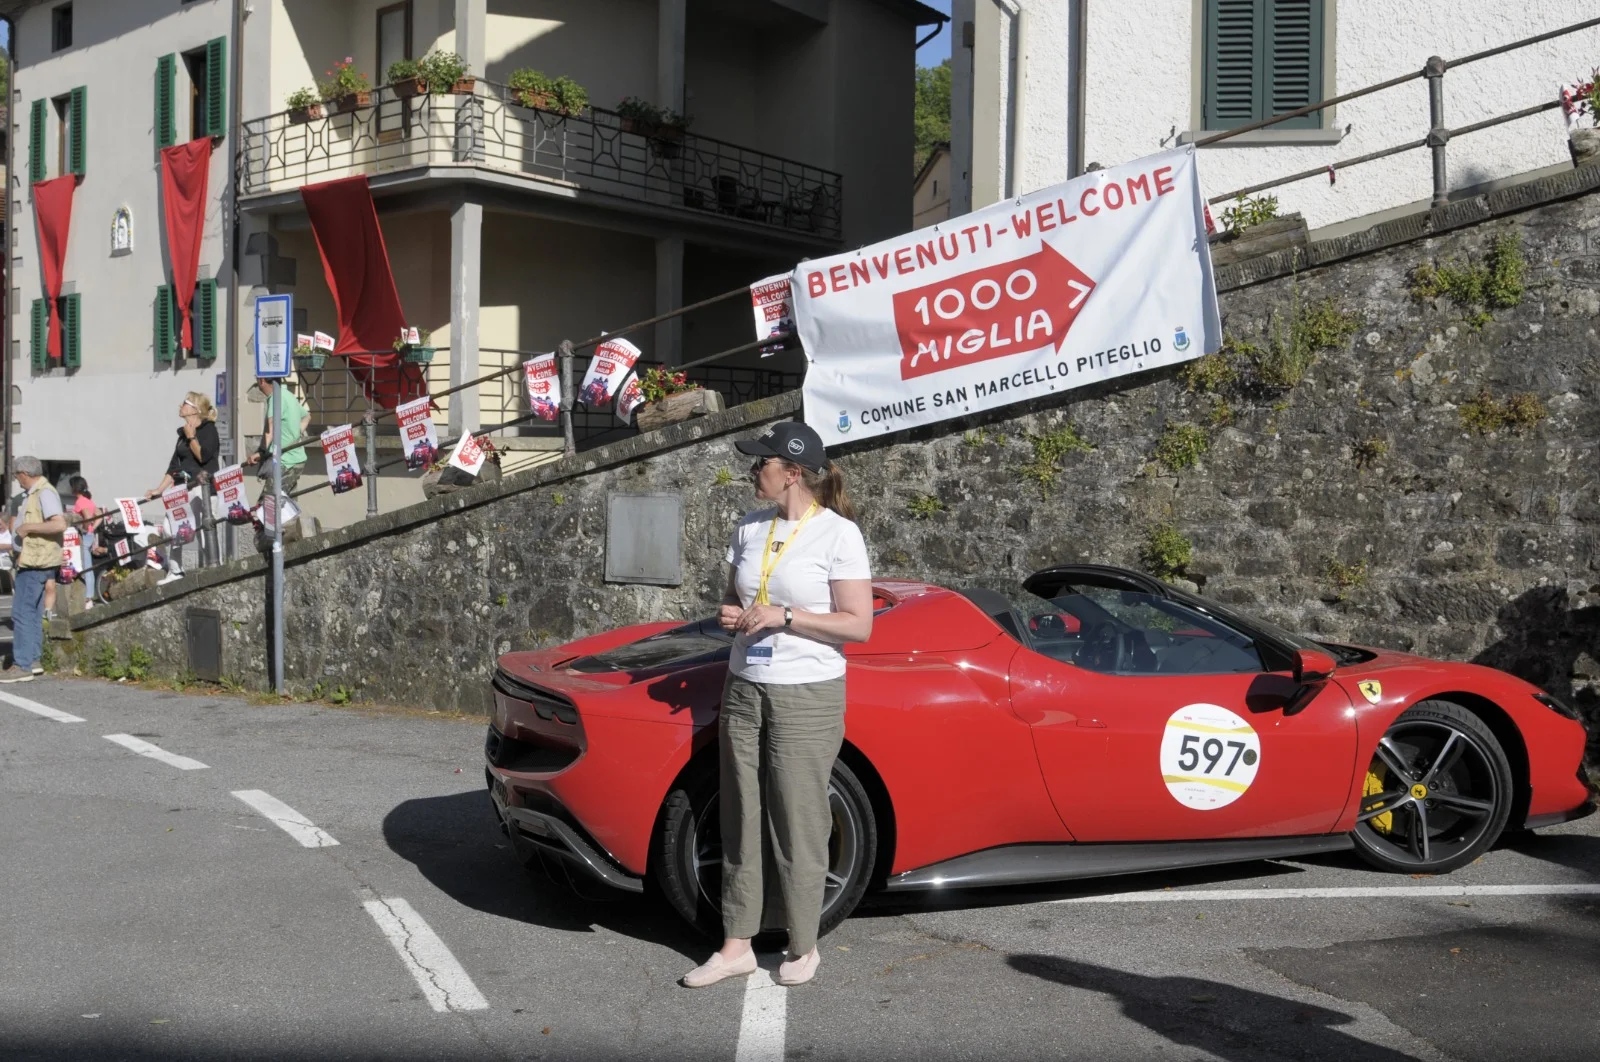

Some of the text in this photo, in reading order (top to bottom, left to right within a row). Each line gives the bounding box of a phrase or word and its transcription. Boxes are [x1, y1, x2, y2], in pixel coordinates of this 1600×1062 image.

[914, 268, 1037, 326] 1000
[910, 308, 1053, 368] MIGLIA
[861, 337, 1162, 425] COMUNE SAN MARCELLO PITEGLIO
[1178, 735, 1246, 777] 597
